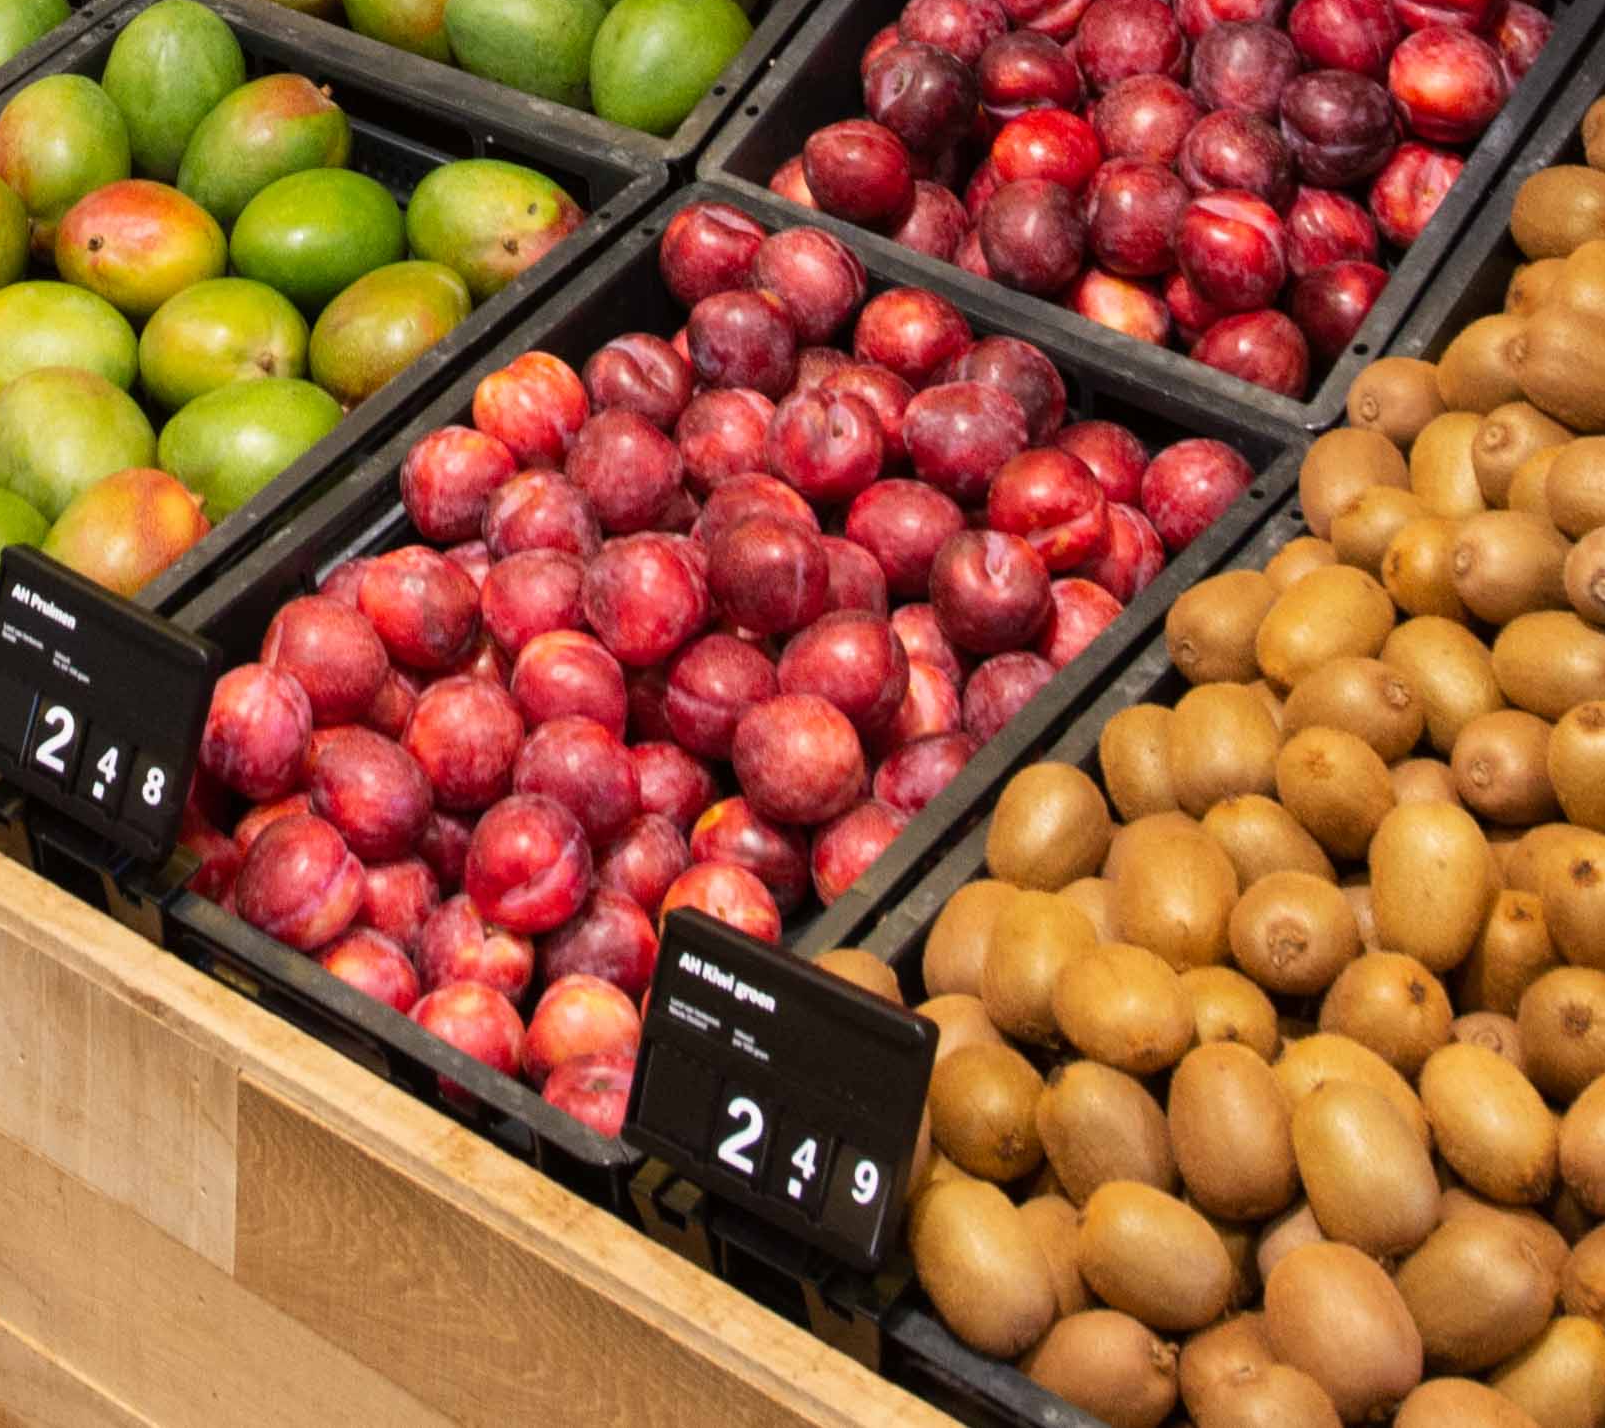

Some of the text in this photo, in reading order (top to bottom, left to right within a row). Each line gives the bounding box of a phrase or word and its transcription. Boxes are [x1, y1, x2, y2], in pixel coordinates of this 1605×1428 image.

[11, 583, 78, 632] AH Pruimen
[35, 706, 165, 807] 2.48
[679, 951, 777, 1013] AH Kiwi groen
[718, 1097, 880, 1205] 2.49
